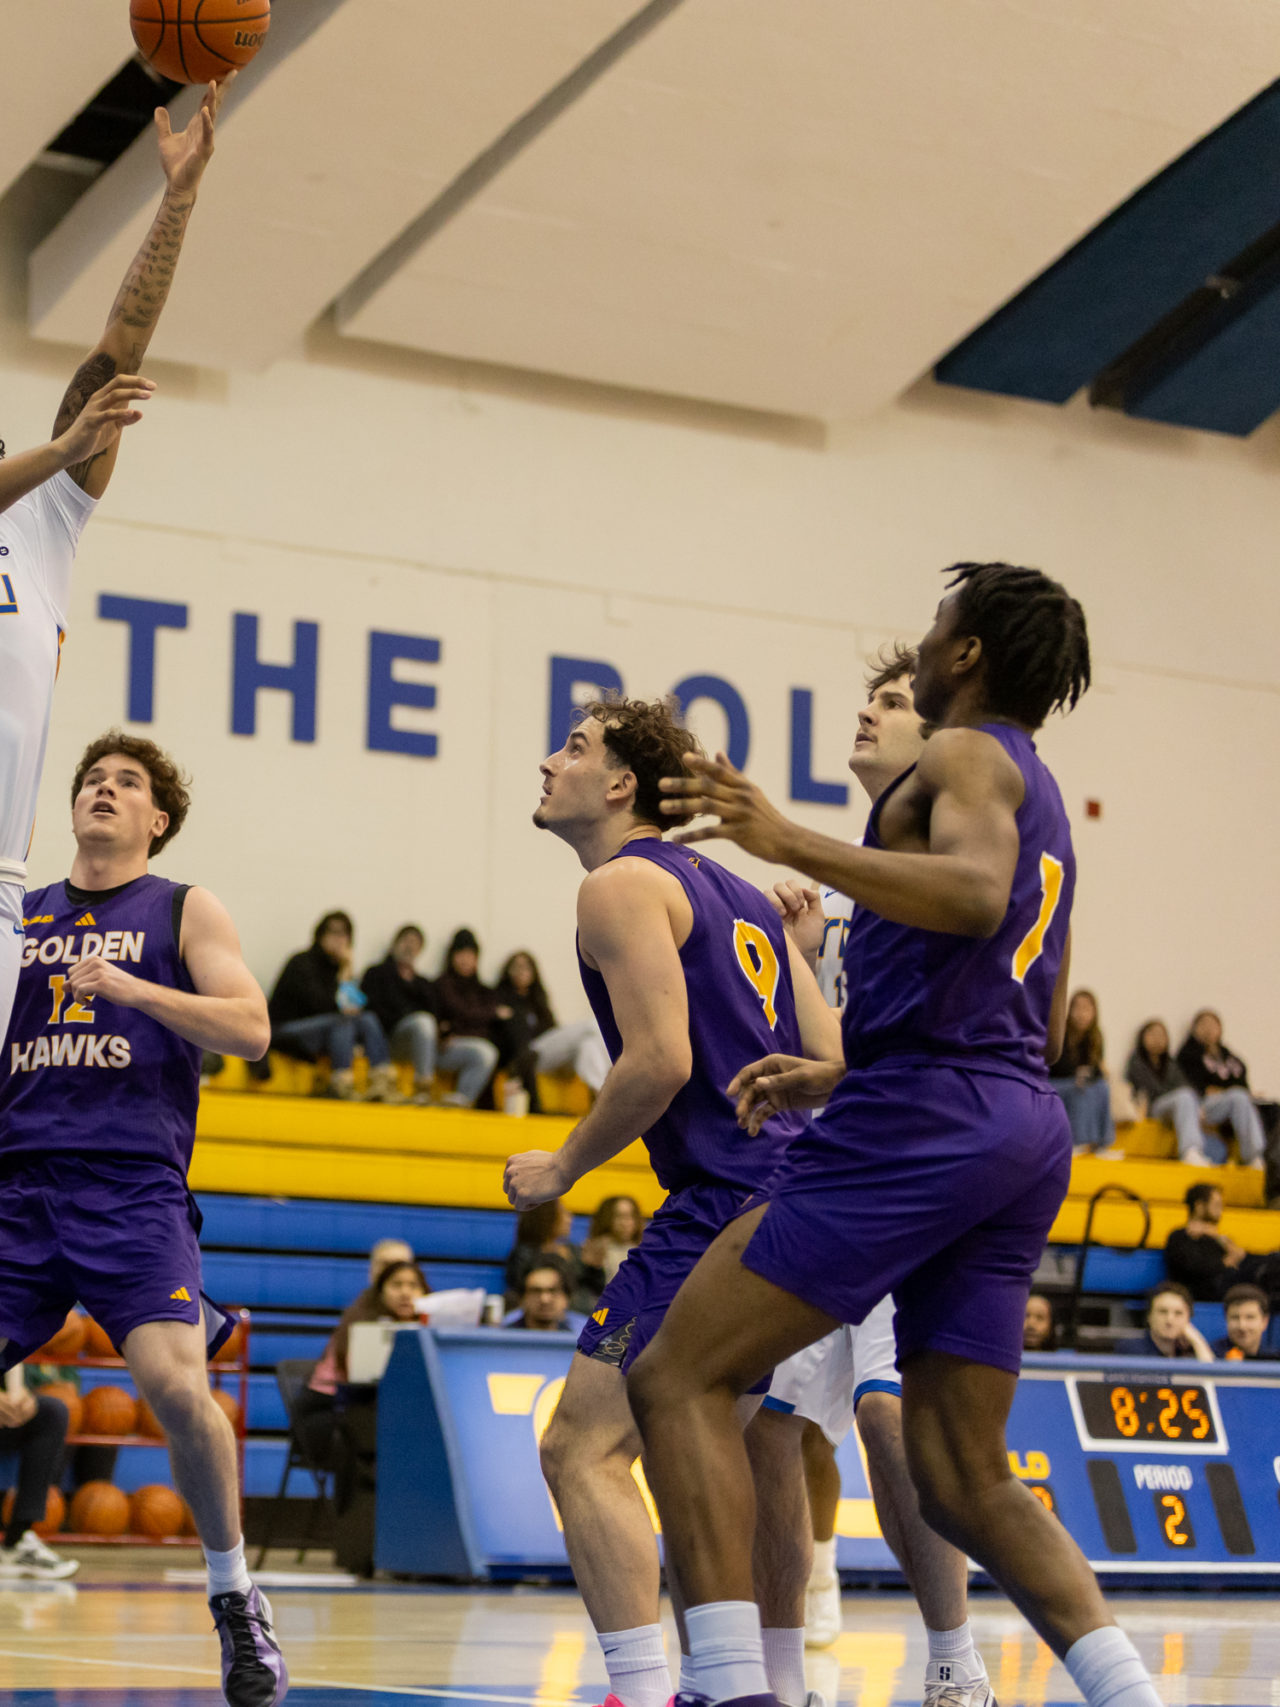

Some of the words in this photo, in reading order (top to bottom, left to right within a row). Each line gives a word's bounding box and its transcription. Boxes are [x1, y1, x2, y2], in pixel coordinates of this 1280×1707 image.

[97, 592, 441, 759] THE
[1011, 850, 1065, 985] 1
[21, 931, 145, 968] GOLDEN
[733, 918, 780, 1032] 9
[10, 1033, 132, 1076] HAWKS
[1110, 1386, 1210, 1439] 8:25
[1132, 1464, 1194, 1491] PERIOD
[1161, 1494, 1188, 1545] 2
